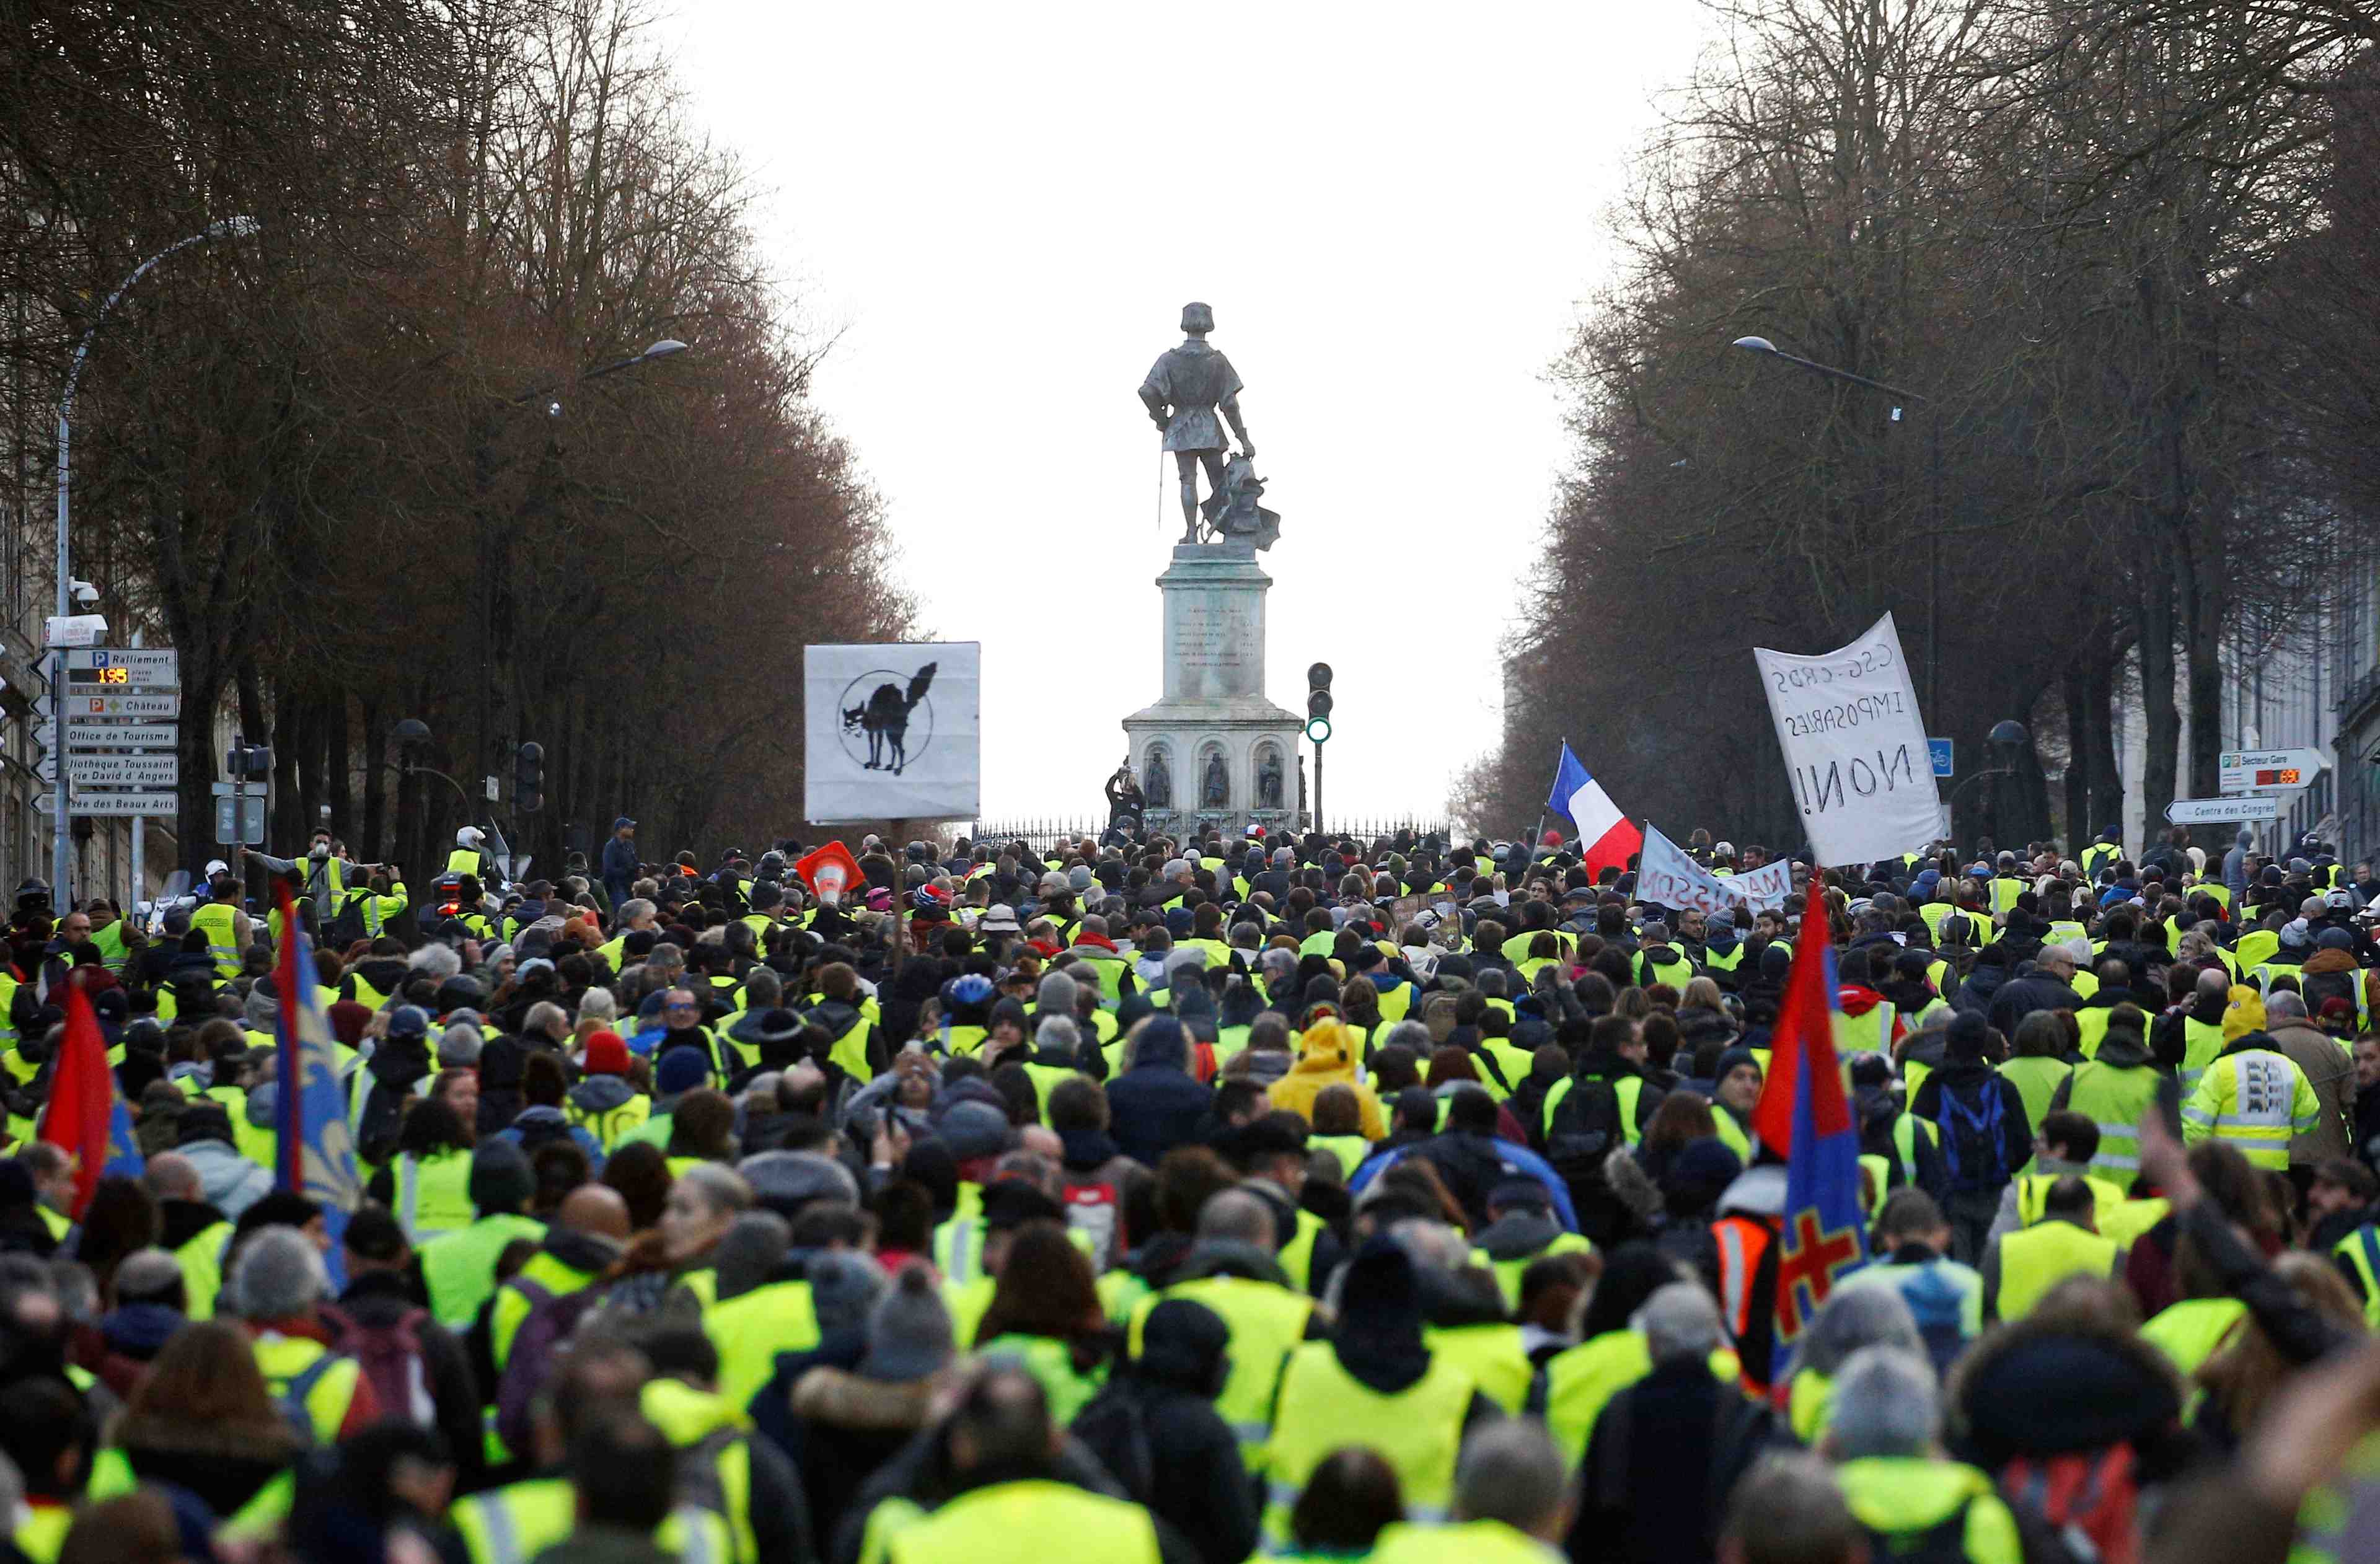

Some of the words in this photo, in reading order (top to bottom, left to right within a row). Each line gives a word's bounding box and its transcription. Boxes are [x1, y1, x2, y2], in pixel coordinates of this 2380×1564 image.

[112, 654, 169, 664] Ralliement
[99, 668, 128, 683] 195
[126, 700, 169, 710] Château
[69, 732, 102, 740] Office
[105, 732, 118, 740] de
[123, 732, 169, 740] Tourisme
[125, 760, 173, 768] Toussaint
[92, 771, 121, 780] David
[94, 799, 111, 808] des
[116, 799, 146, 808] Beaux
[152, 799, 174, 808] Arts
[2195, 807, 2221, 816] Centre
[2225, 806, 2238, 814] des
